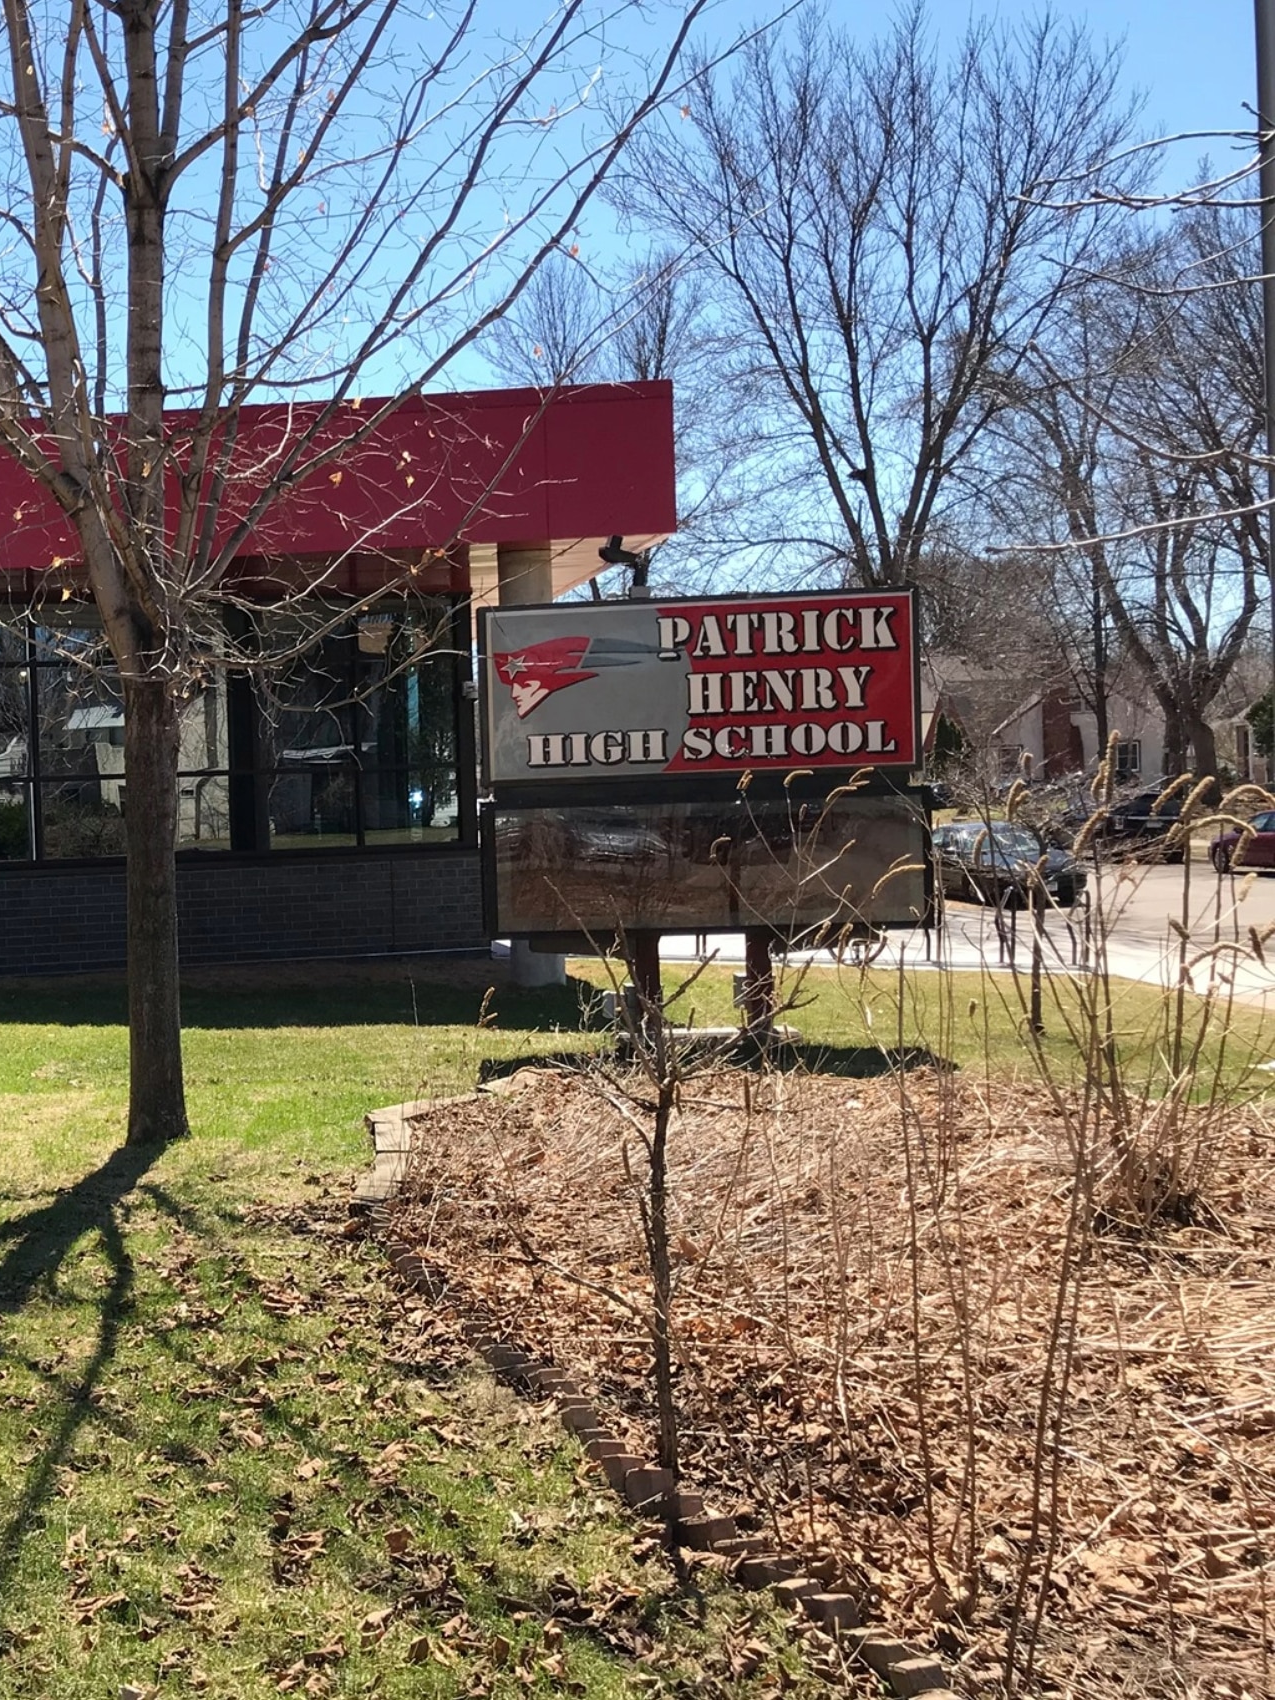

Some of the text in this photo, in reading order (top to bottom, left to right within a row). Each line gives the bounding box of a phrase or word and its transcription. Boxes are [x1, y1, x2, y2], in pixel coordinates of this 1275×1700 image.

[656, 606, 898, 659] PATRICK
[686, 665, 872, 715] HENRY
[527, 720, 896, 766] HIGH SCHOOL
